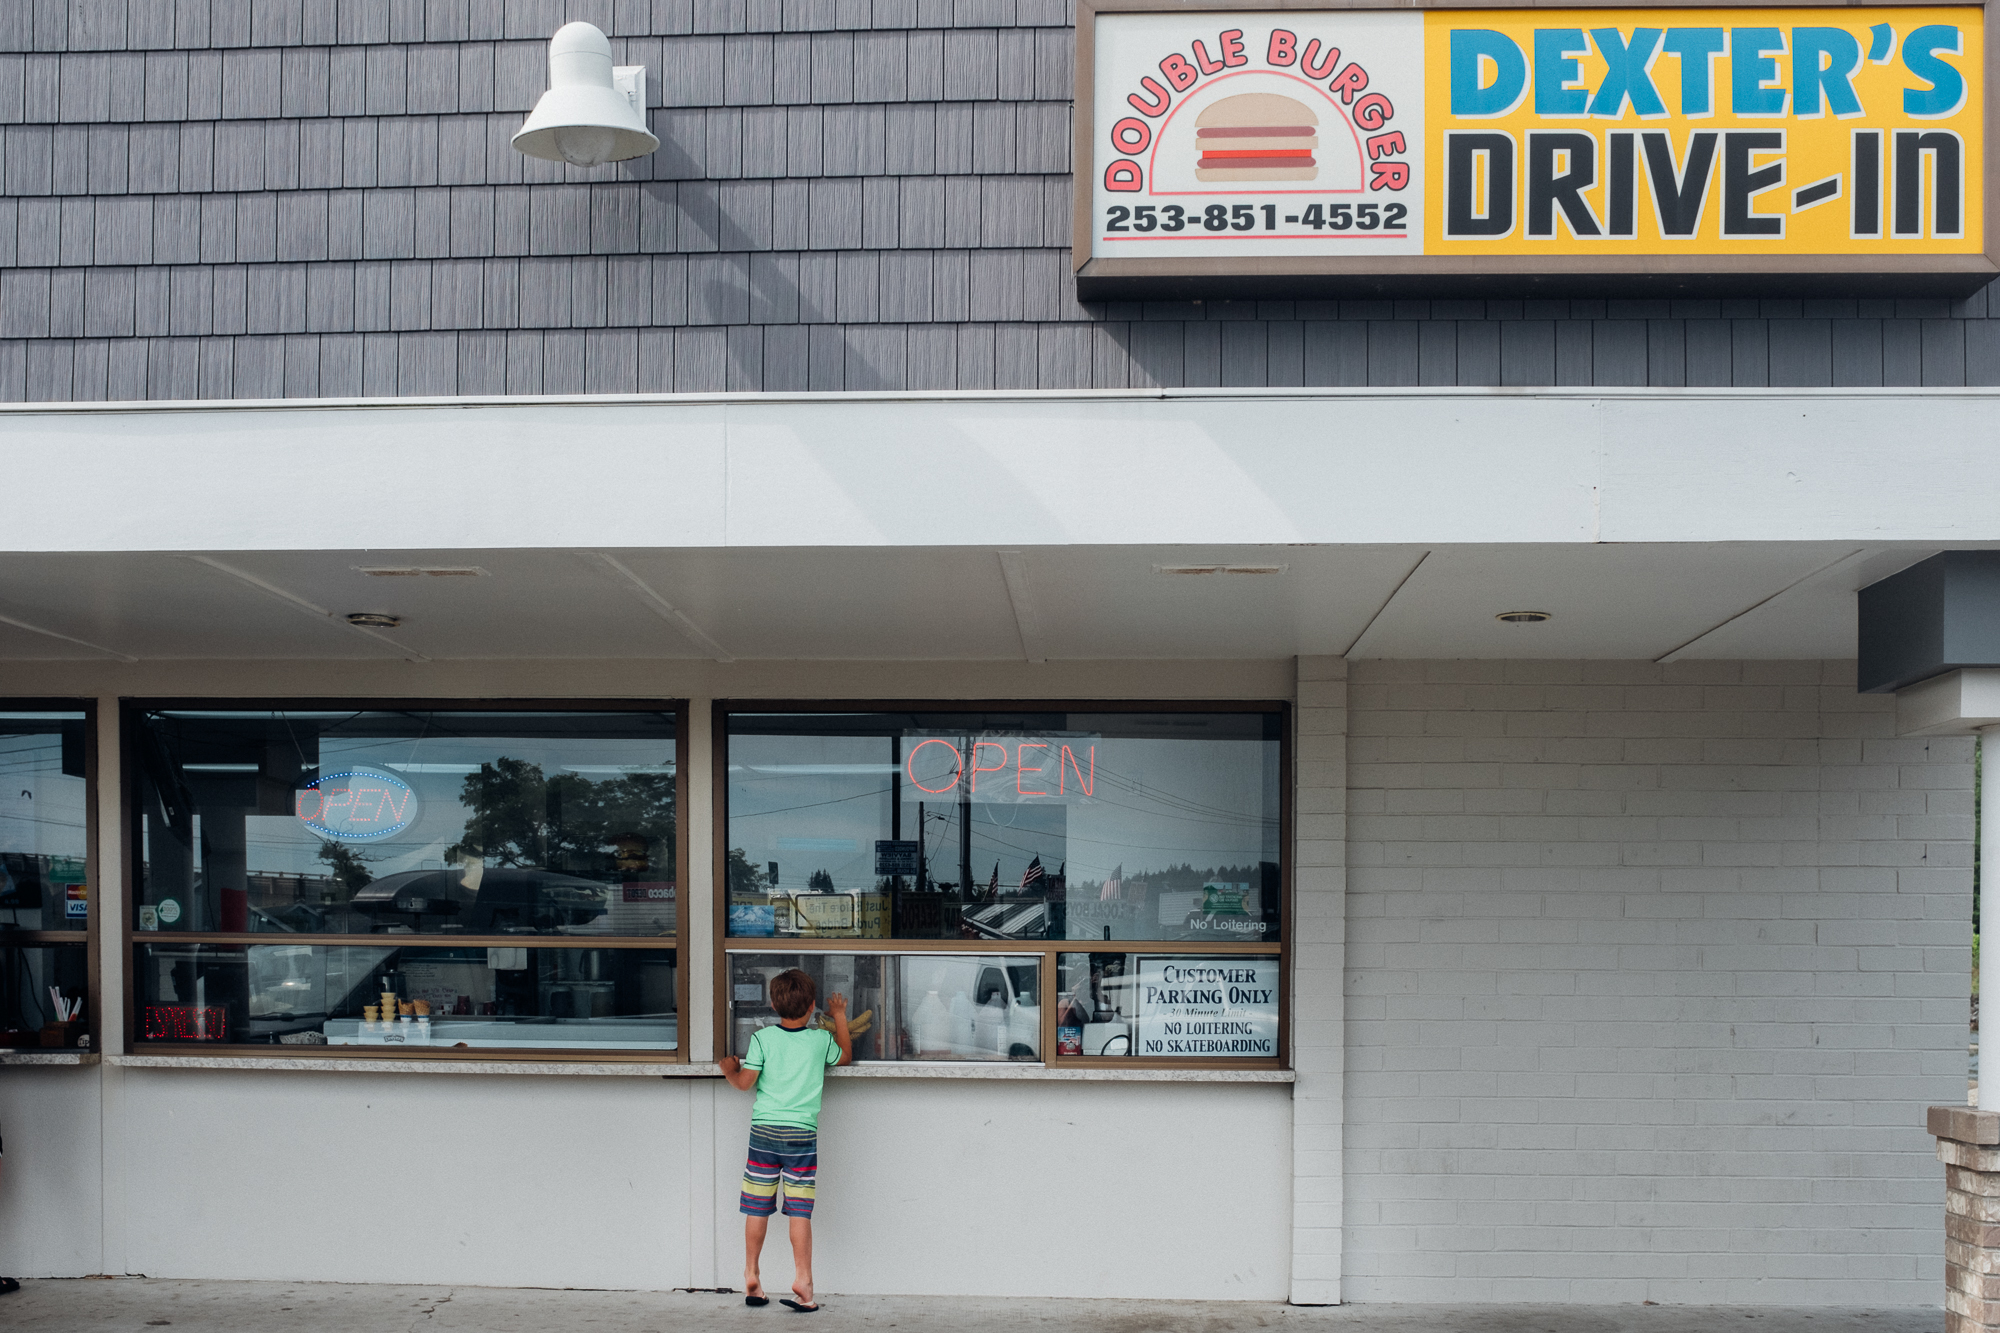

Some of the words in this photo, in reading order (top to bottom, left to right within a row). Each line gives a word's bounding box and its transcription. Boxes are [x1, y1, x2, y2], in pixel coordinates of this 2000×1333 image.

[1450, 22, 1968, 120] DEXTER'S
[1104, 28, 1247, 193] DOUBLE
[1266, 28, 1410, 192] BURGER
[1442, 129, 1965, 240] DRIVE-IN
[1105, 202, 1408, 233] 253-851-4552
[908, 739, 1095, 796] OPEN
[297, 788, 411, 822] OPEN
[1190, 919, 1207, 930] No
[1213, 918, 1267, 932] Loitering
[1163, 965, 1256, 983] CUSTOMER
[1146, 986, 1222, 1004] PARKING
[1228, 986, 1273, 1004] ONLY
[146, 1007, 226, 1039] ESPRESSO
[1164, 1022, 1182, 1035] NO
[1186, 1022, 1253, 1035] LOITERING
[1169, 1008, 1182, 1018] 30
[1184, 1008, 1219, 1018] Minute
[1145, 1040, 1163, 1053] NO
[1167, 1039, 1271, 1053] SKATEBOARDING
